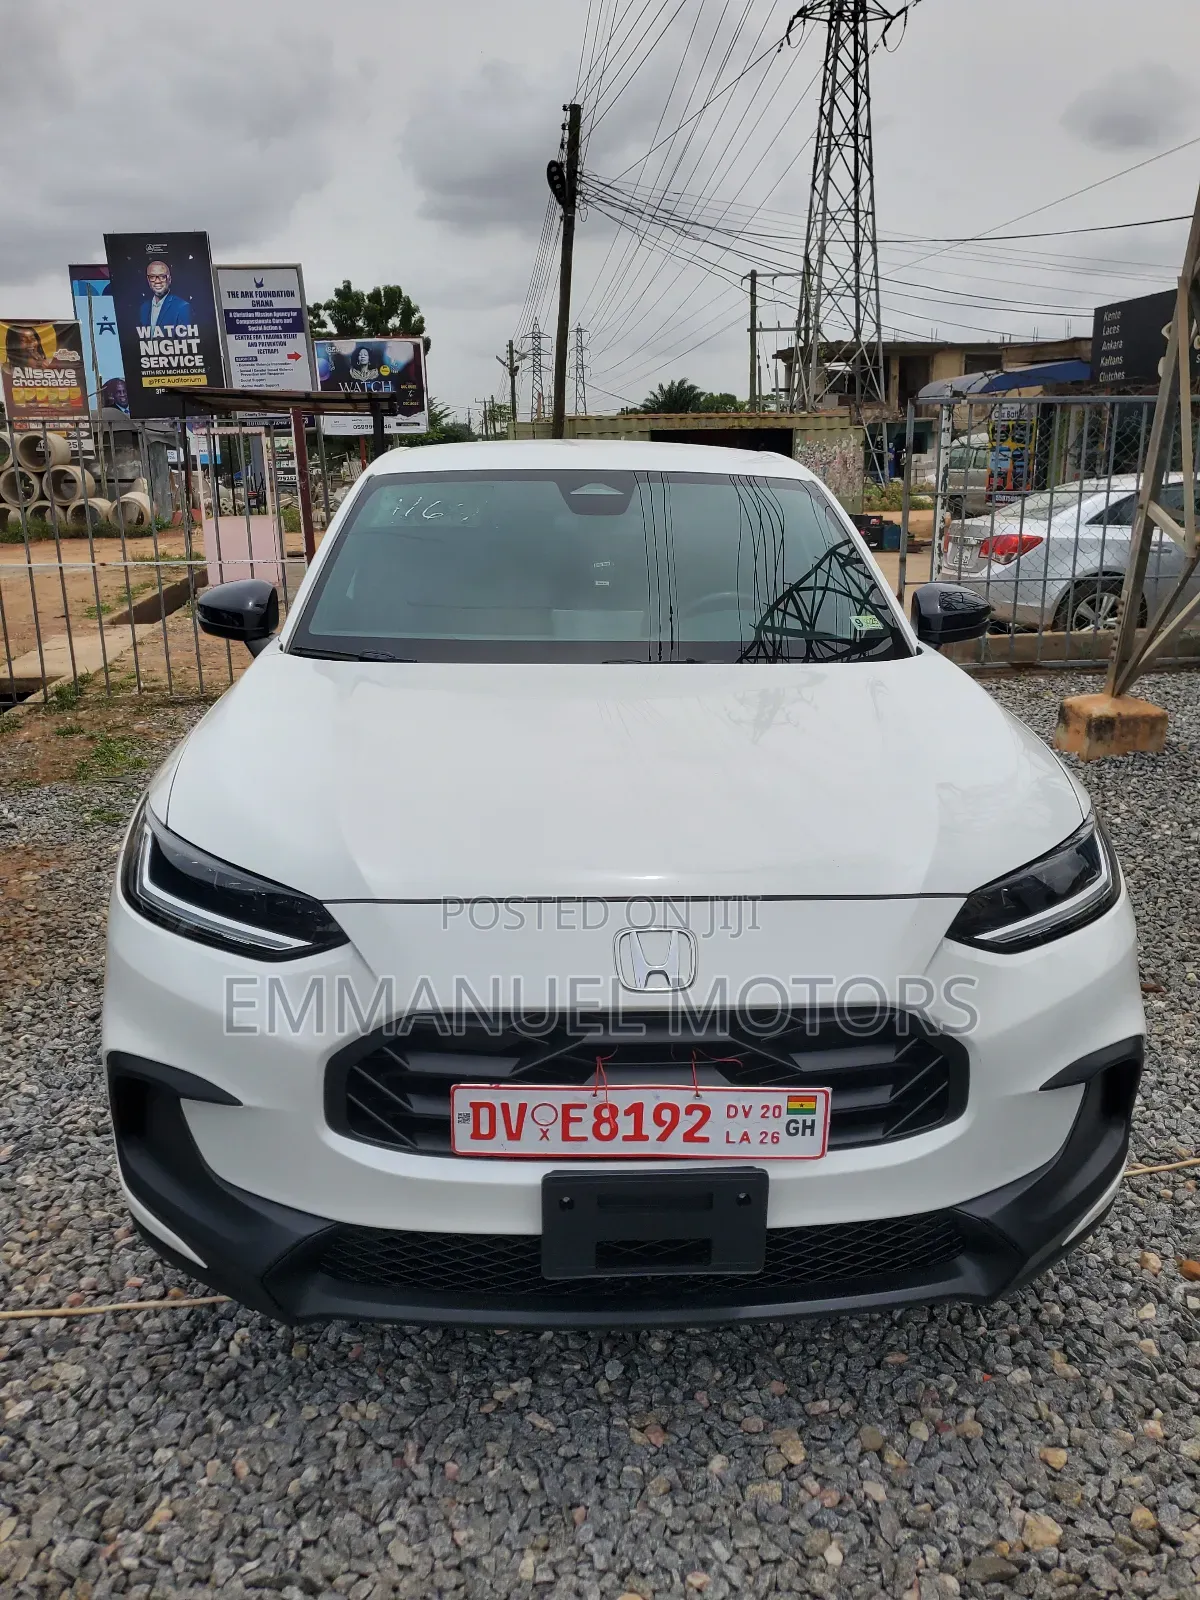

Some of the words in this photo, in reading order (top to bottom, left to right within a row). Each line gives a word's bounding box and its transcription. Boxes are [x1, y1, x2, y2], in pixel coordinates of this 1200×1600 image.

[255, 290, 295, 298] FOUNDATION
[1103, 311, 1121, 321] Kente
[136, 324, 199, 339] WATCH
[1102, 325, 1120, 336] Laces
[140, 339, 201, 355] NIGHT
[1101, 340, 1124, 351] Ankara
[141, 355, 204, 368] SERVICE
[1100, 355, 1124, 367] Kaftans
[12, 366, 76, 379] Allsave
[1099, 371, 1126, 383] Clutches
[12, 378, 78, 387] chocolates
[338, 381, 392, 392] WATCH
[726, 1104, 753, 1119] DV
[760, 1104, 783, 1119] 20
[469, 1101, 528, 1141] DV
[561, 1101, 712, 1143] E8192
[785, 1118, 816, 1137] GH
[725, 1130, 752, 1144] LA
[759, 1130, 781, 1145] 26
